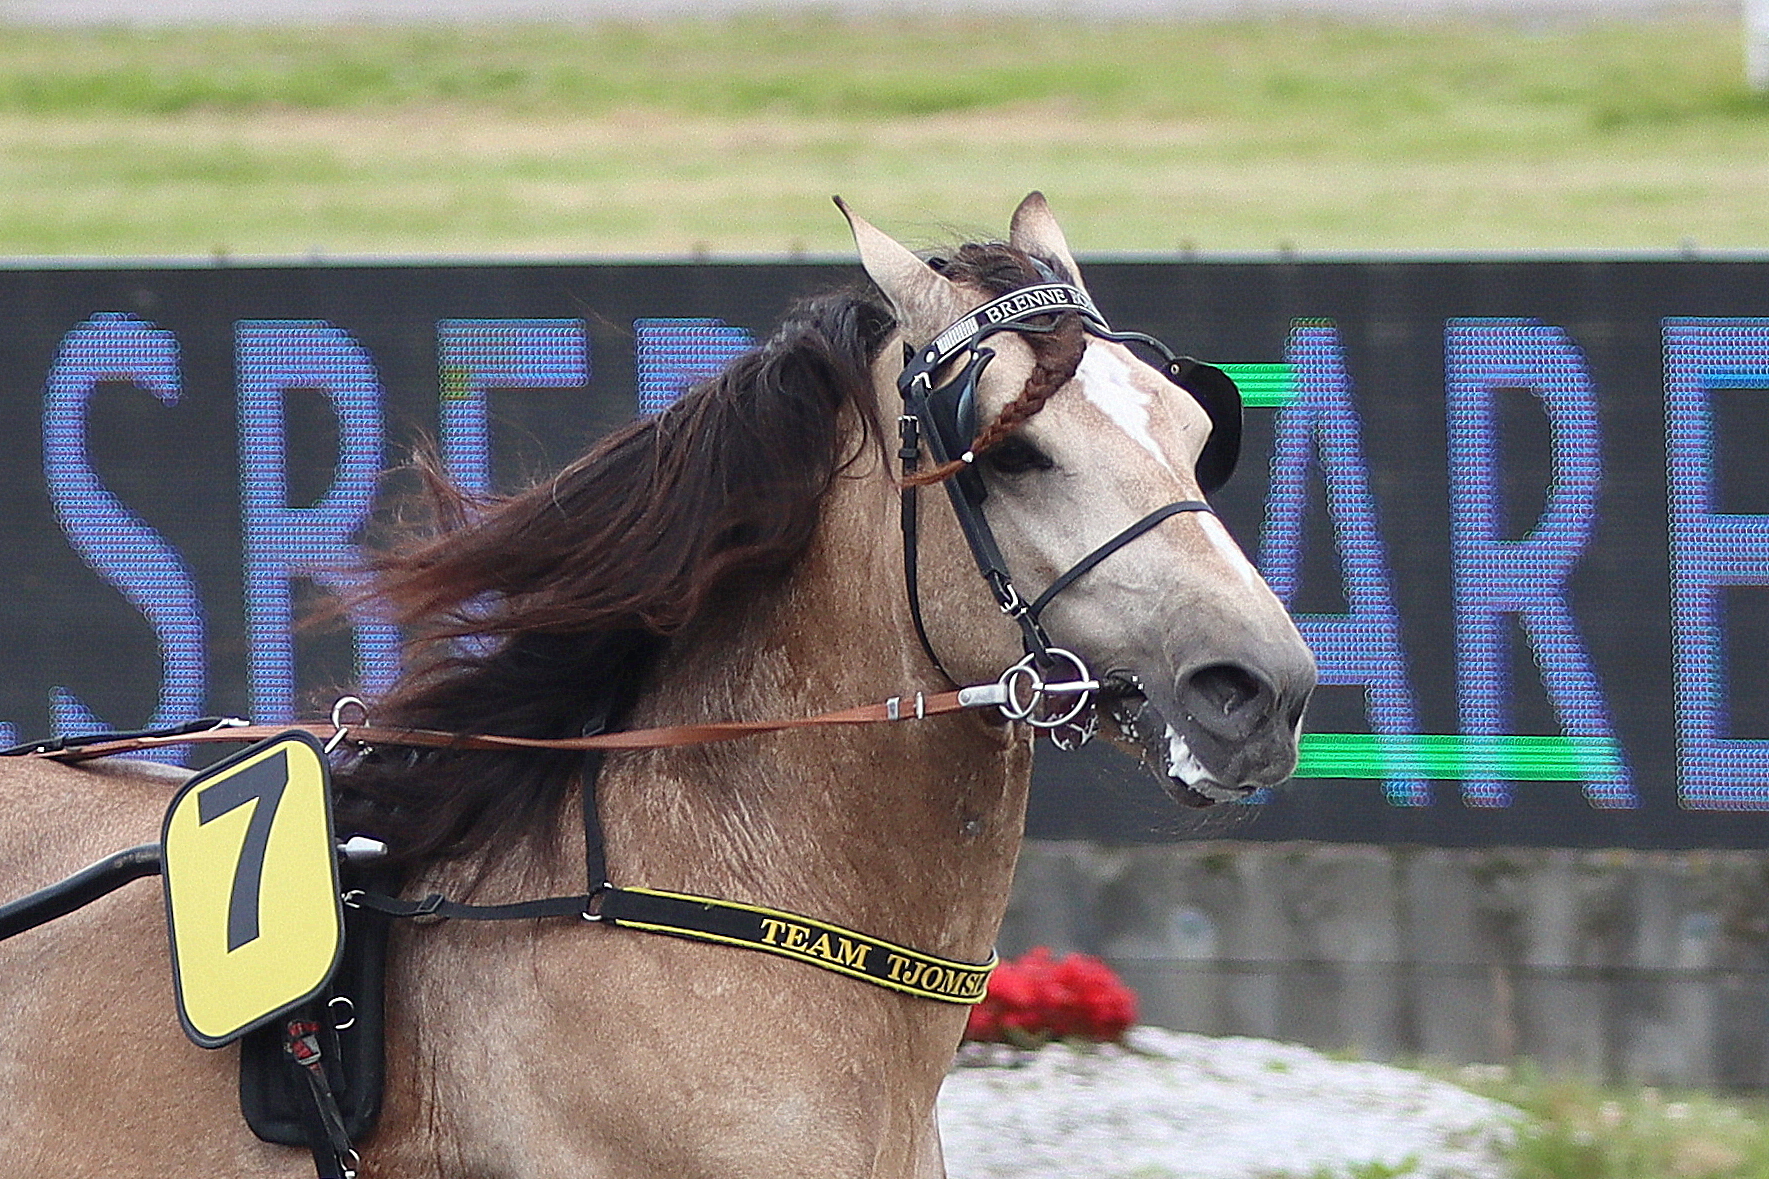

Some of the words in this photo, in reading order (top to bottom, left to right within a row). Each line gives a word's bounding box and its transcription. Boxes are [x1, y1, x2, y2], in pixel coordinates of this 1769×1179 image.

[985, 288, 1068, 324] BRENNE
[198, 747, 290, 955] 7
[760, 918, 872, 971] TEAM
